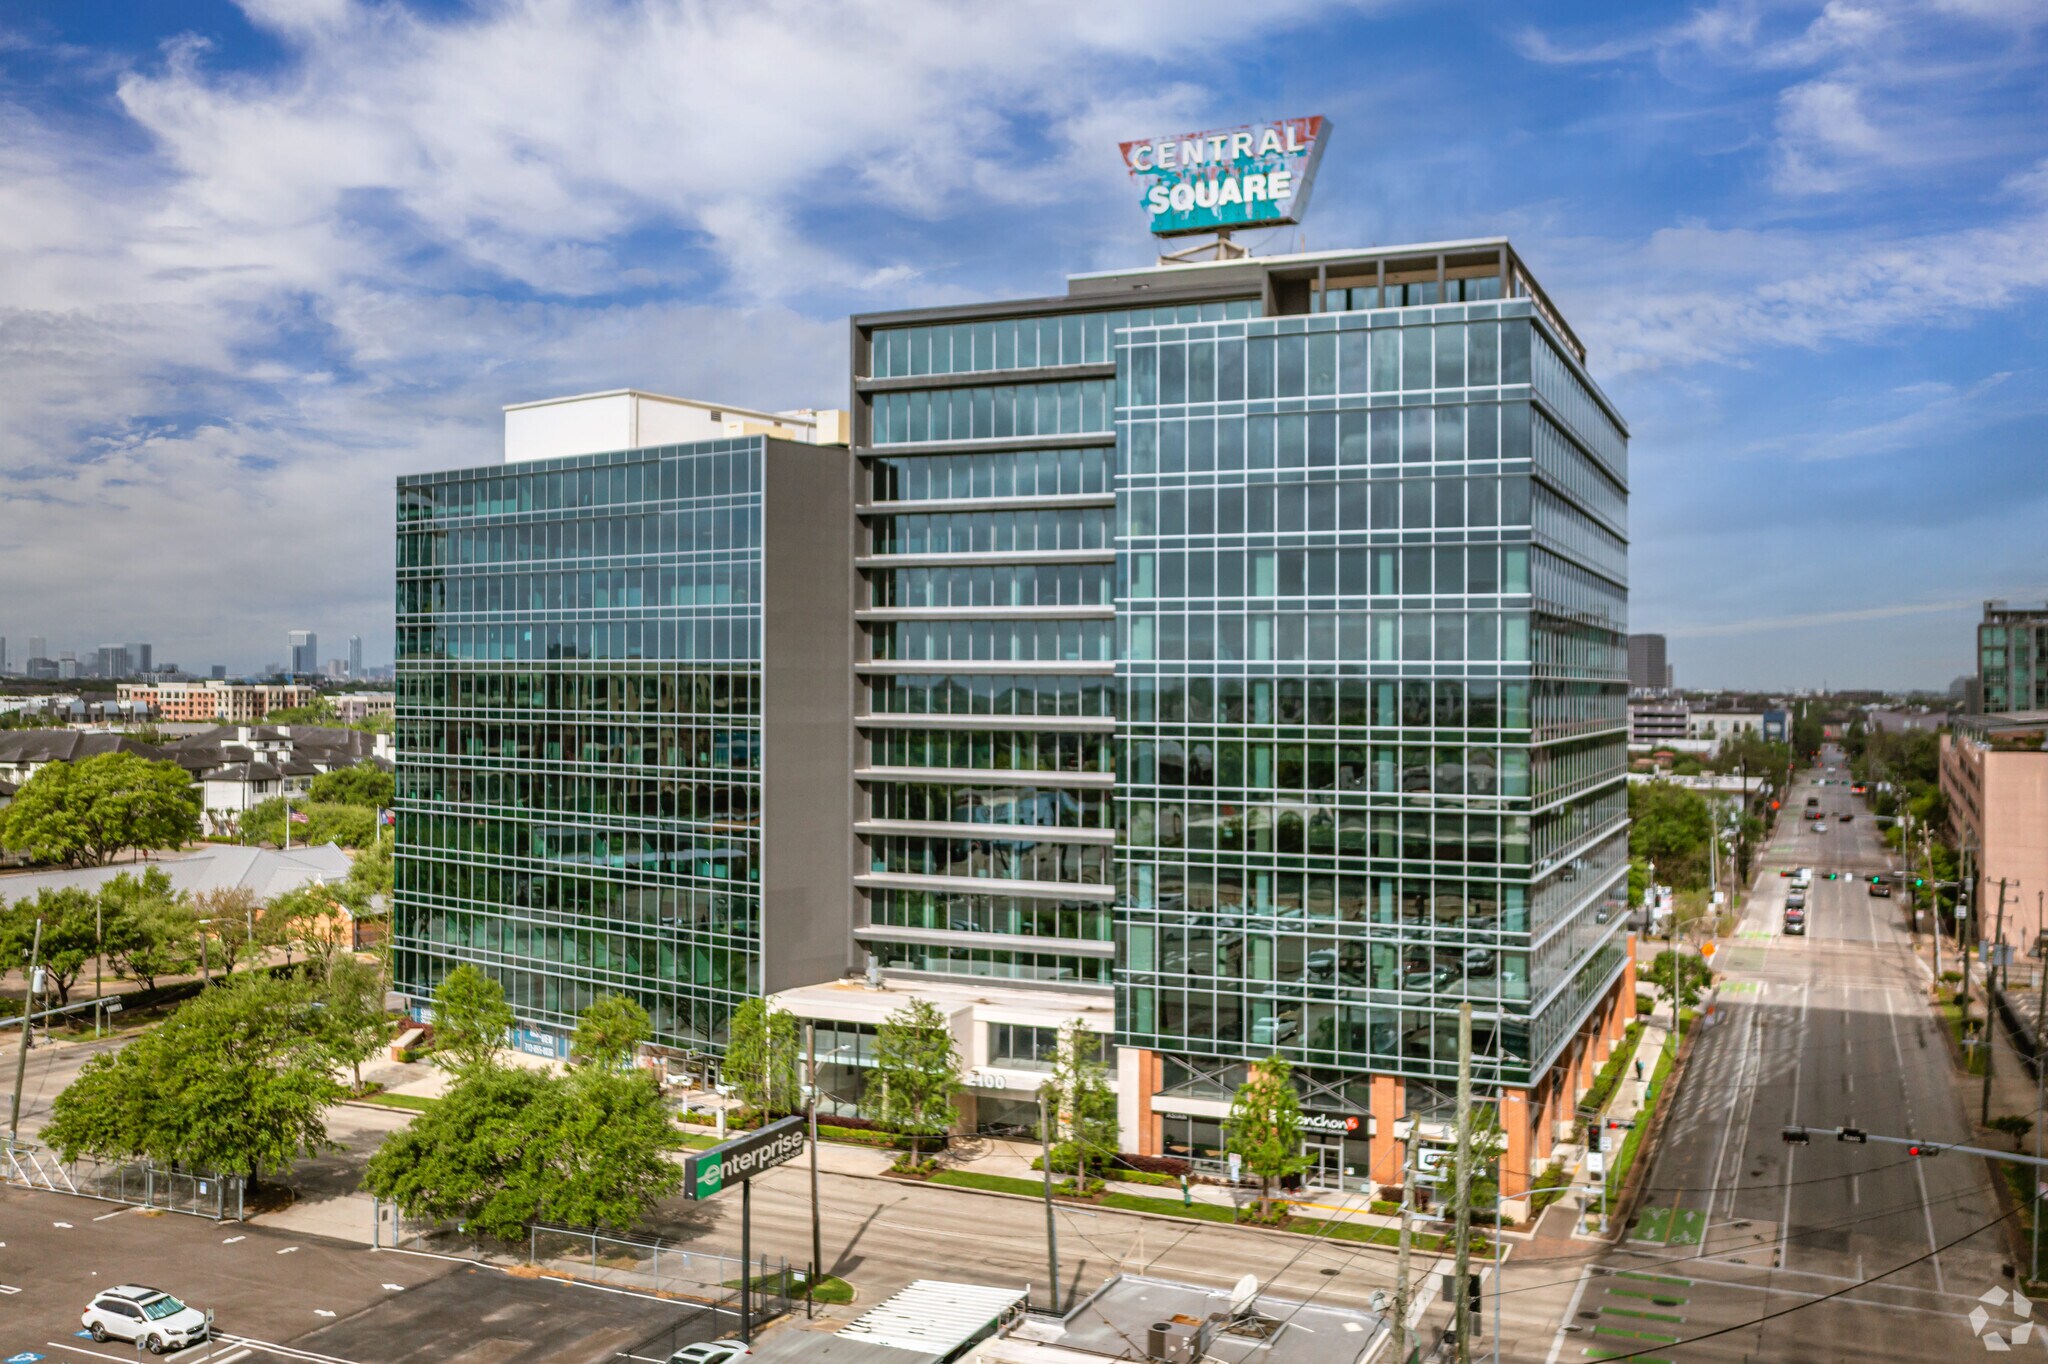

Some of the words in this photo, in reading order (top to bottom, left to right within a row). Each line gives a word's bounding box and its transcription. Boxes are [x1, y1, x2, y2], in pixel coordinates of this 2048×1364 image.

[1132, 126, 1305, 171] CENTRAL
[1148, 171, 1292, 214] SQUARE
[697, 1131, 804, 1186] enterprise
